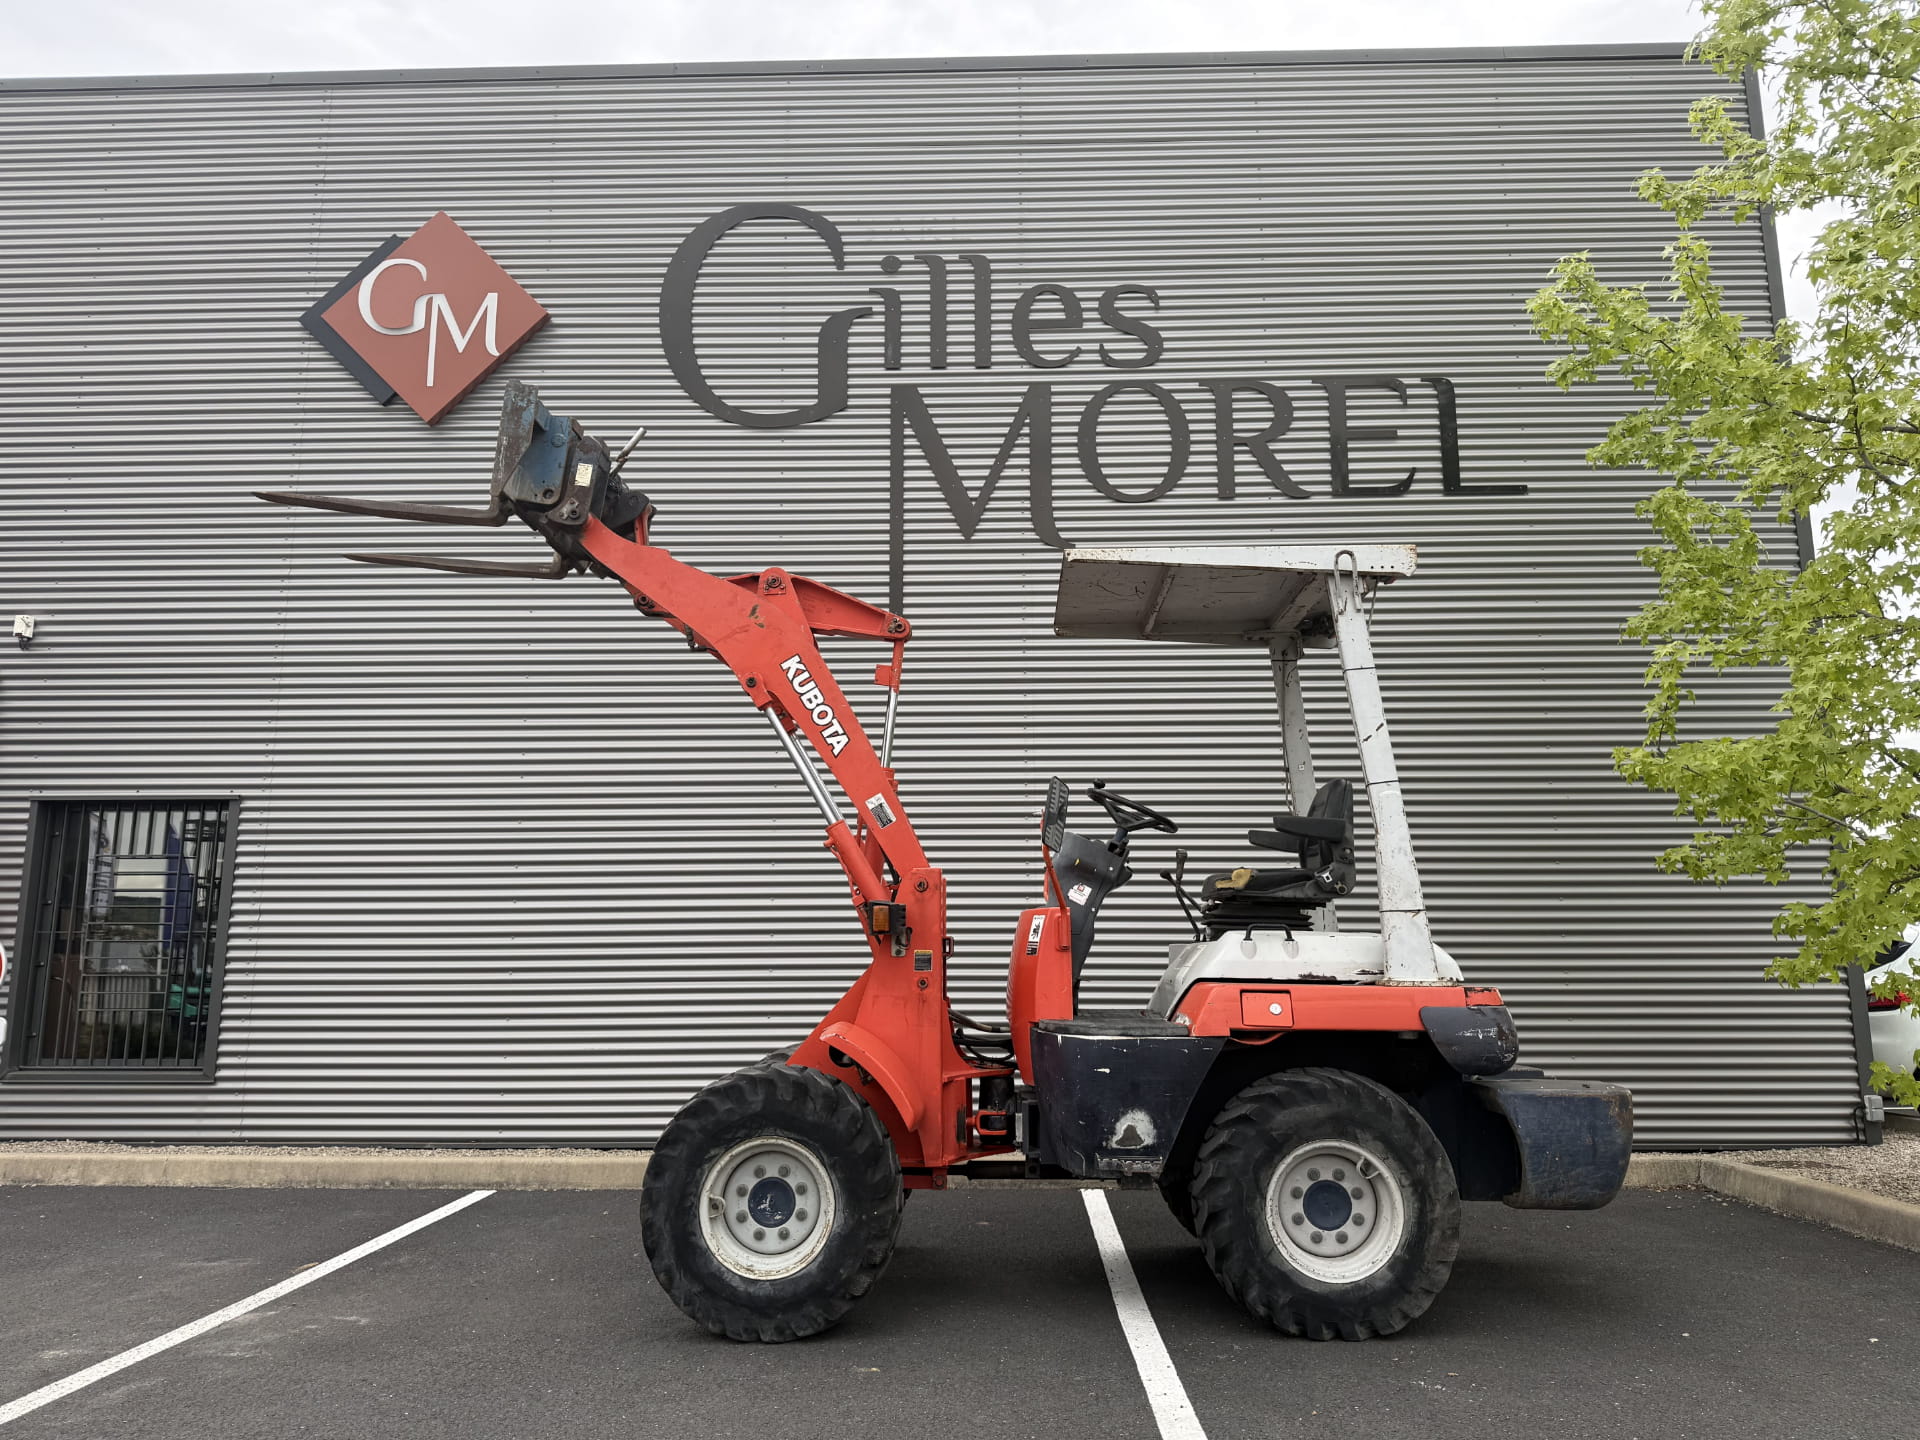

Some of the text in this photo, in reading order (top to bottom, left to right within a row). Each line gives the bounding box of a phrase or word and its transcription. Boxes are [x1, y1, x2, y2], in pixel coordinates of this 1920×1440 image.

[357, 258, 500, 387] GM
[659, 203, 1164, 428] Gilles
[889, 377, 1528, 615] MOREL
[780, 654, 851, 758] KUBOTA
